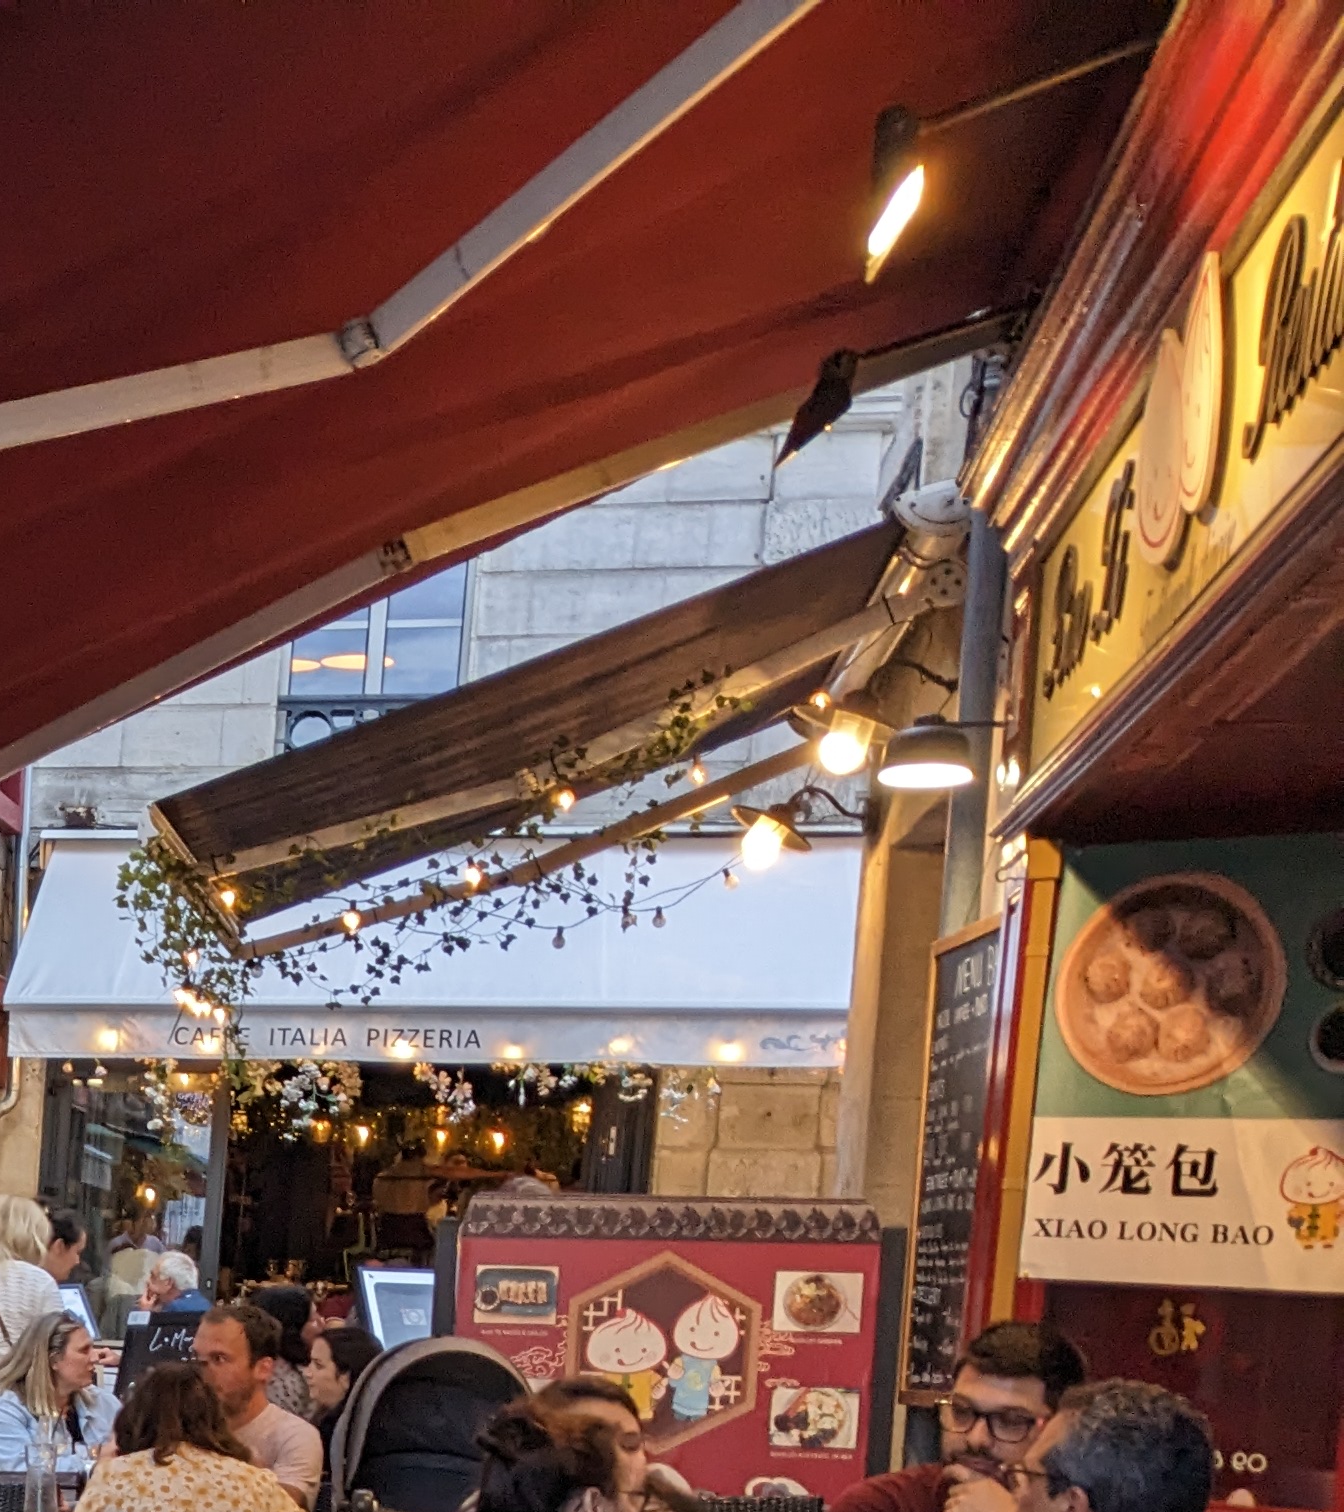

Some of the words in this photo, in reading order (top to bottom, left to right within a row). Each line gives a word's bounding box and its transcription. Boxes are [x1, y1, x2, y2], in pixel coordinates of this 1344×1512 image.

[268, 1026, 347, 1050] ITALIA
[365, 1026, 482, 1051] PIZZERIA
[1032, 1140, 1220, 1199] 小笼包
[1032, 1216, 1109, 1243] XIAO
[1117, 1219, 1200, 1245] LONG
[1210, 1221, 1276, 1247] BAO
